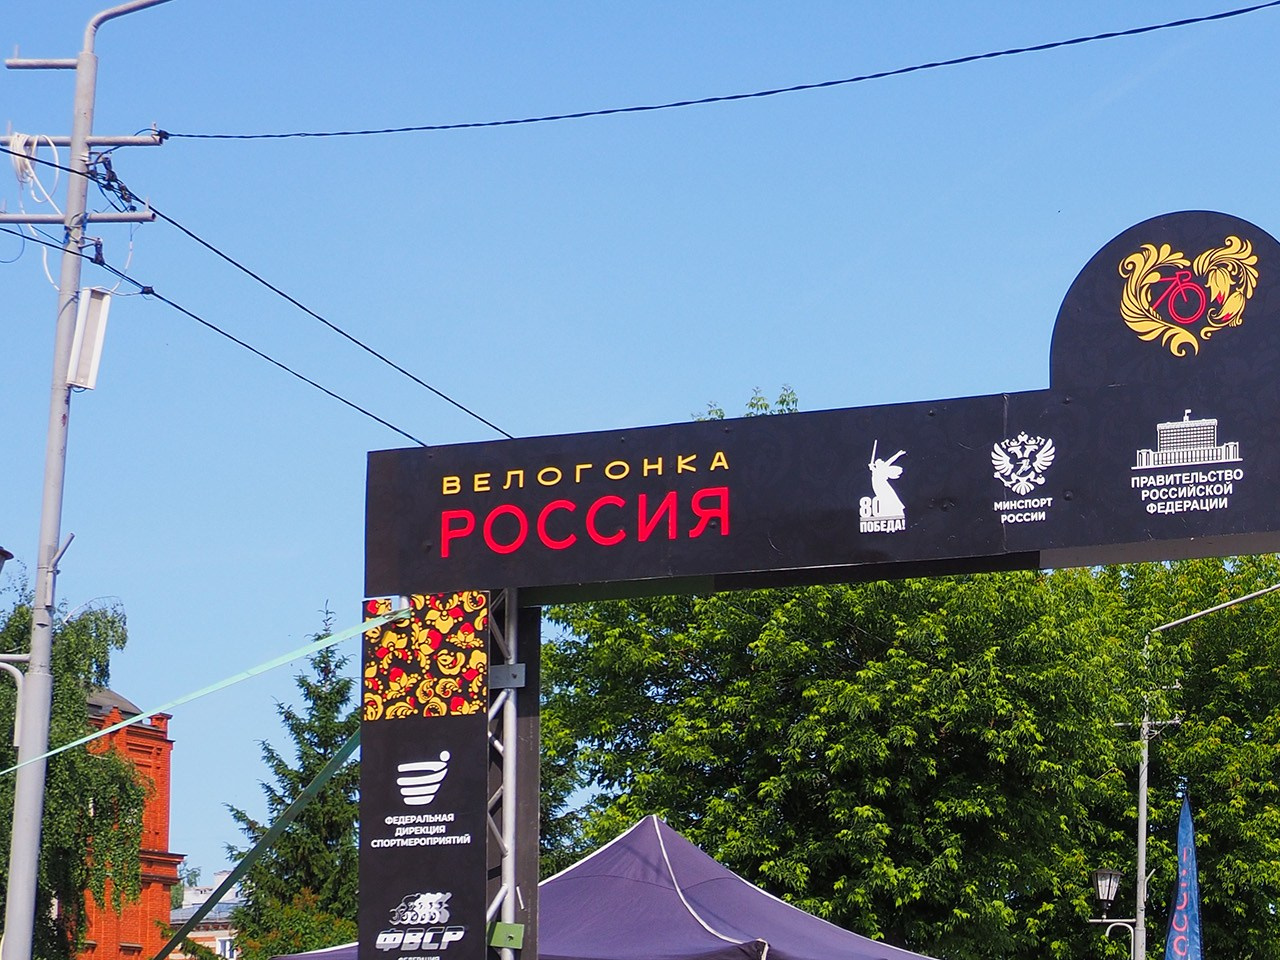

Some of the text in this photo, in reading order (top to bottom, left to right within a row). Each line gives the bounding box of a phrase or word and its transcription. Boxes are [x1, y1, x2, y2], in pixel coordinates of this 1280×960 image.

[442, 451, 731, 496] ВЕЛОГОНКА
[1130, 468, 1244, 489] ПРАВИТЕЛЬСТВО
[1140, 481, 1234, 502] РОССИЙСКОЙ
[993, 497, 1054, 512] МИНСПОРТ
[1145, 497, 1229, 516] ФЕДЕРАЦИИ
[439, 485, 731, 559] РОССИЯ
[859, 518, 907, 534] ПОБЕДА!
[1000, 511, 1047, 525] РОССИИ
[384, 813, 455, 826] ФЕДЕРАЛЬНАЯ
[394, 824, 446, 838] ДИРЕКЦИЯ
[370, 833, 471, 849] СПОРТМЕРОПРИЯТИЙ
[375, 925, 466, 952] ФВСР
